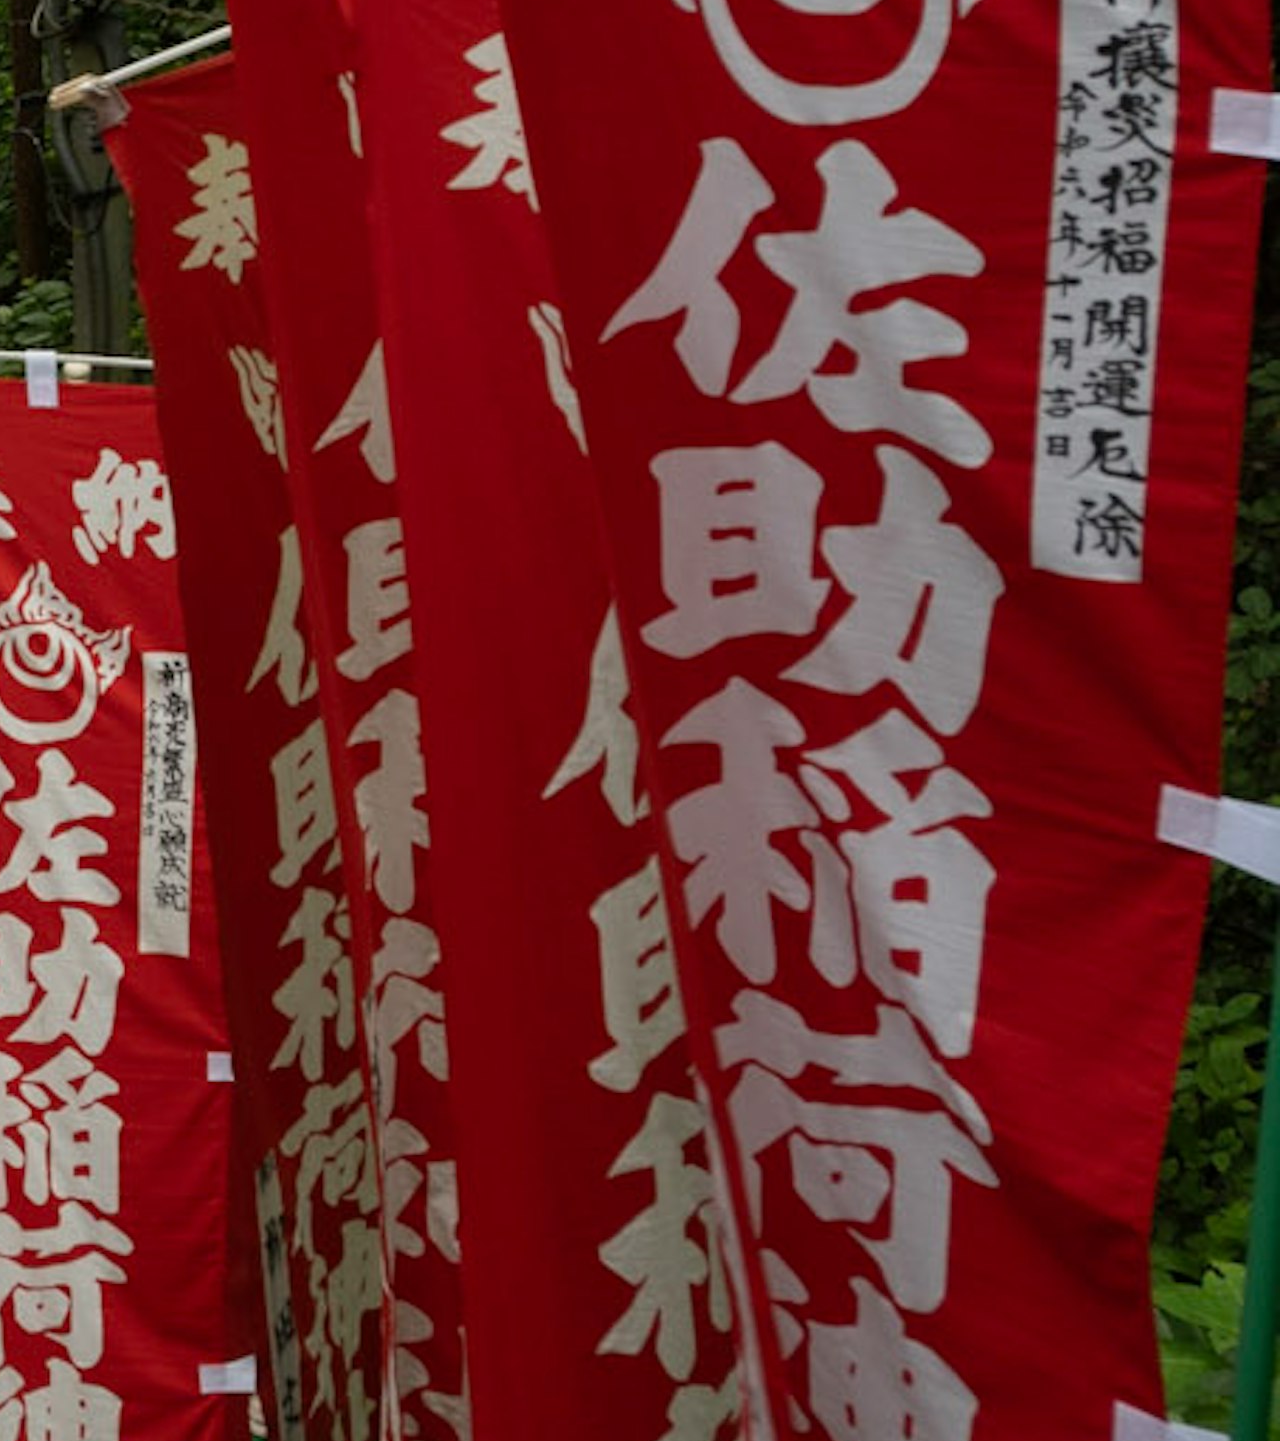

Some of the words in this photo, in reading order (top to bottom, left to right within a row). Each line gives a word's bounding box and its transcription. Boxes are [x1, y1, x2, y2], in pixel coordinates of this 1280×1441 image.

[1043, 81, 1098, 460] 令和六年十一月吉日
